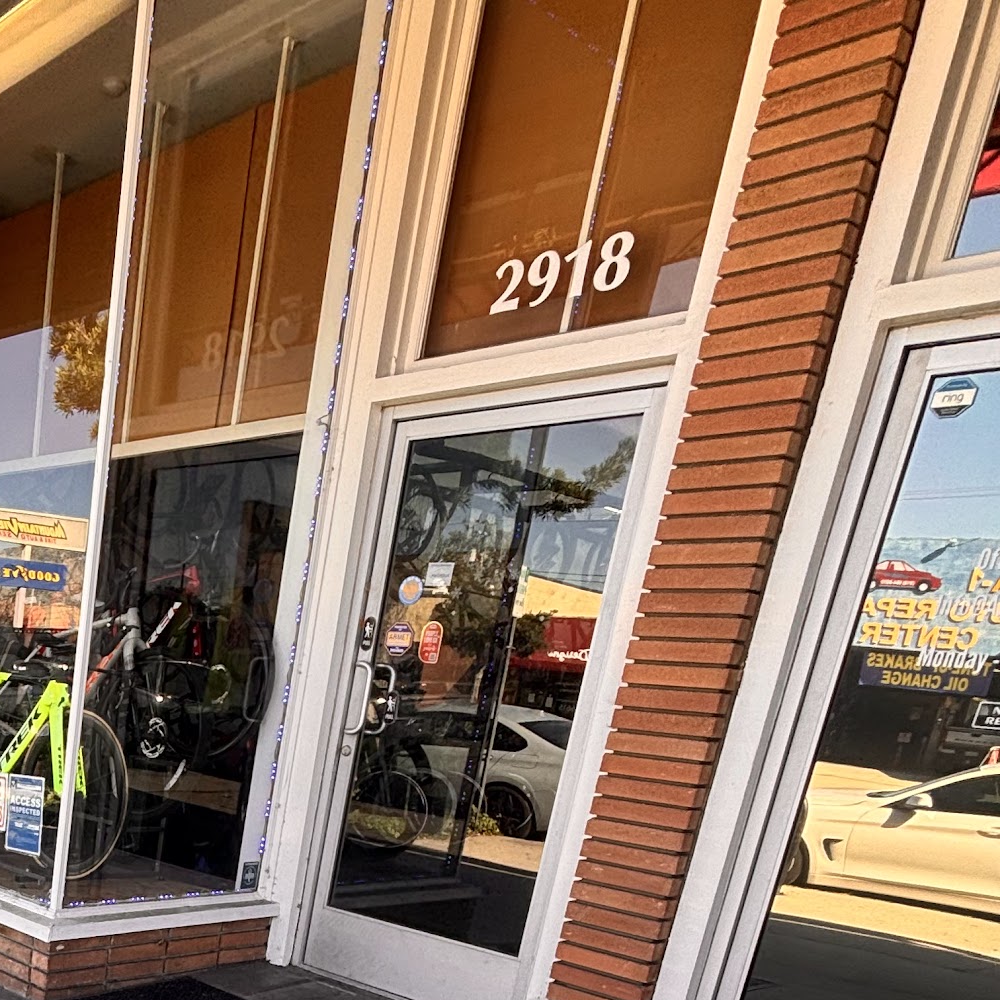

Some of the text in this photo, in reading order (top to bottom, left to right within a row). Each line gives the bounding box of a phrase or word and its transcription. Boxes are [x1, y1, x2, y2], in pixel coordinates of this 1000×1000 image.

[489, 230, 635, 316] 2918
[916, 646, 990, 675] Monday
[10, 794, 41, 808] ACCESS
[10, 806, 40, 817] INSPECTED
